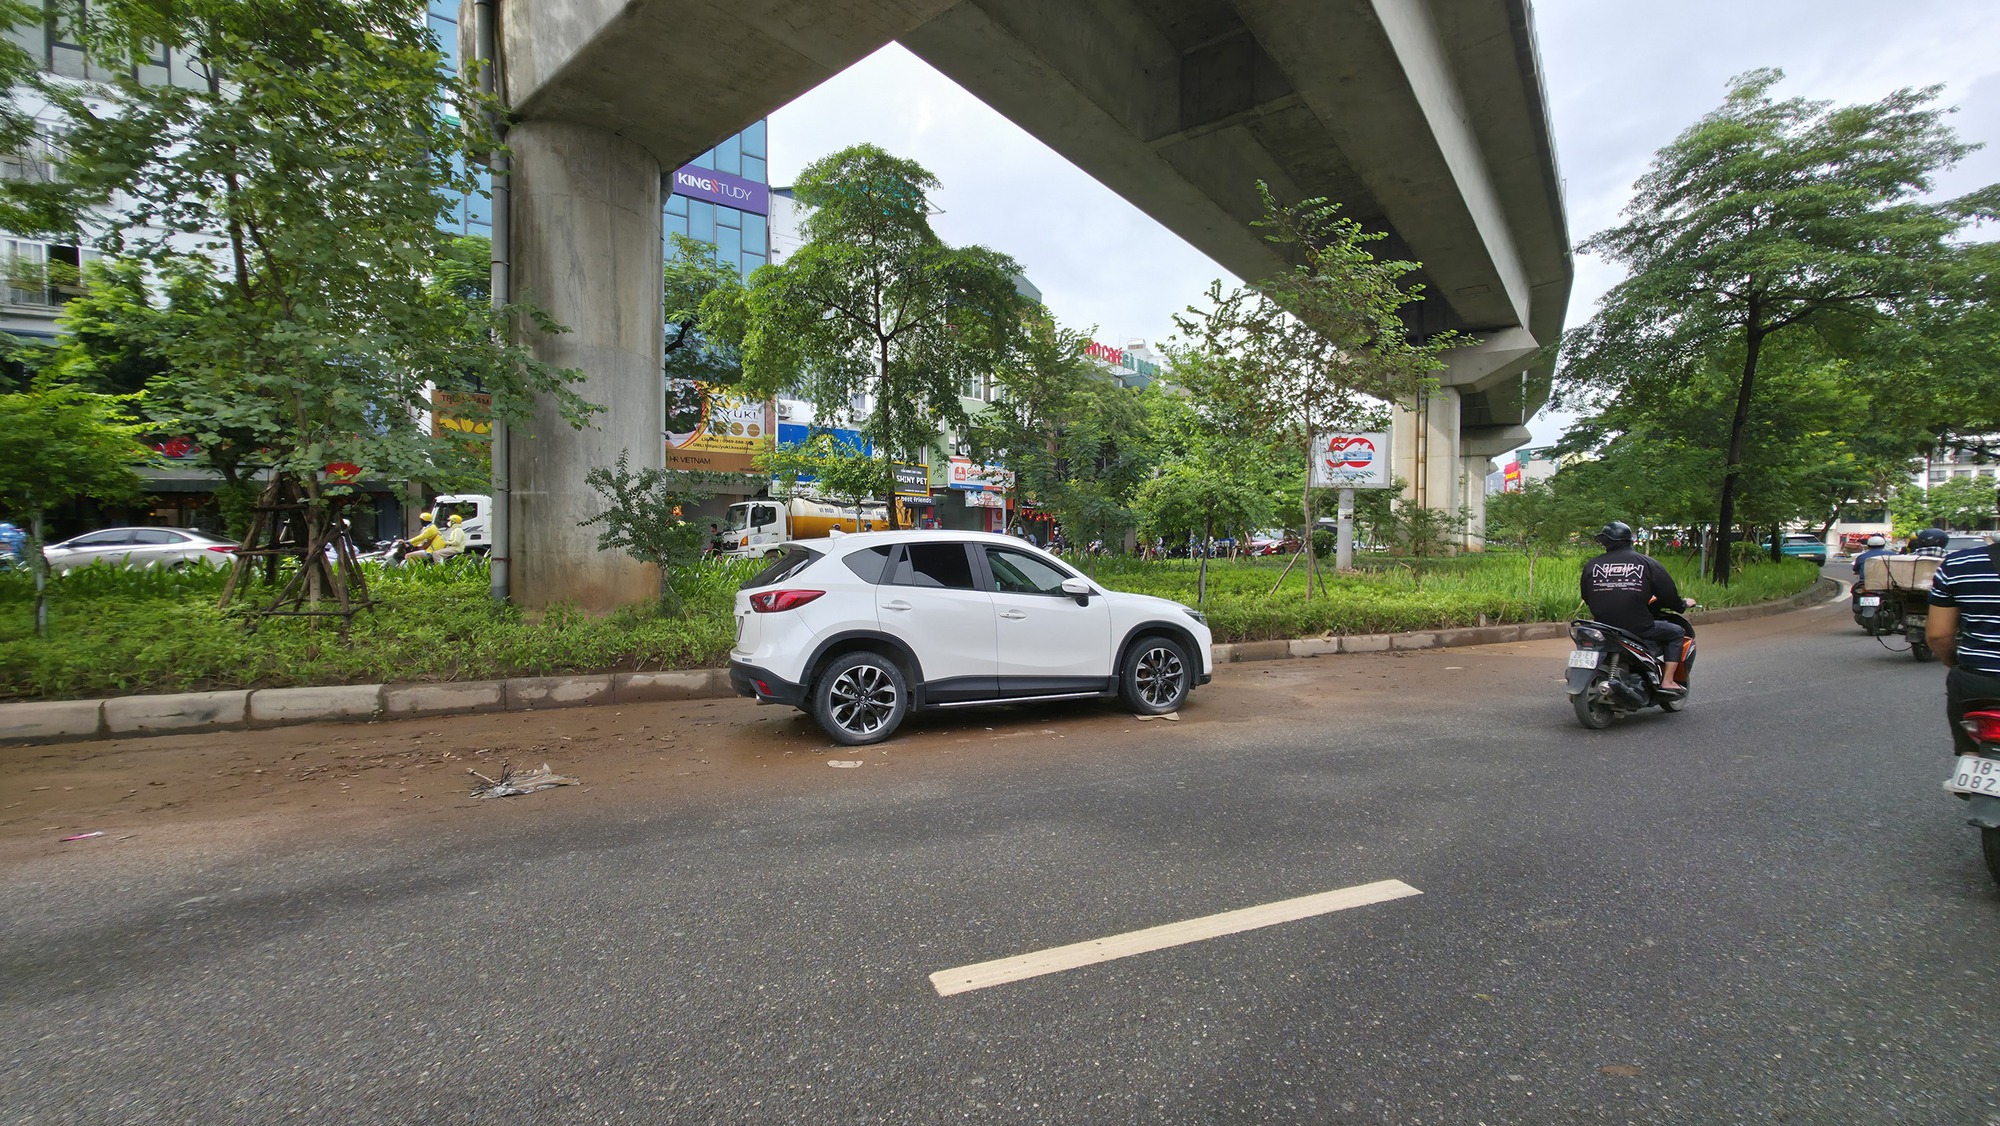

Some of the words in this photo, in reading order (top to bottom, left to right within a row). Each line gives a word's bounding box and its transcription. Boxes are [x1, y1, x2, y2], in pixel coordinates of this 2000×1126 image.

[896, 474, 915, 484] SHINY
[916, 477, 928, 486] PET
[913, 496, 932, 504] friends
[1592, 563, 1644, 579] NOW
